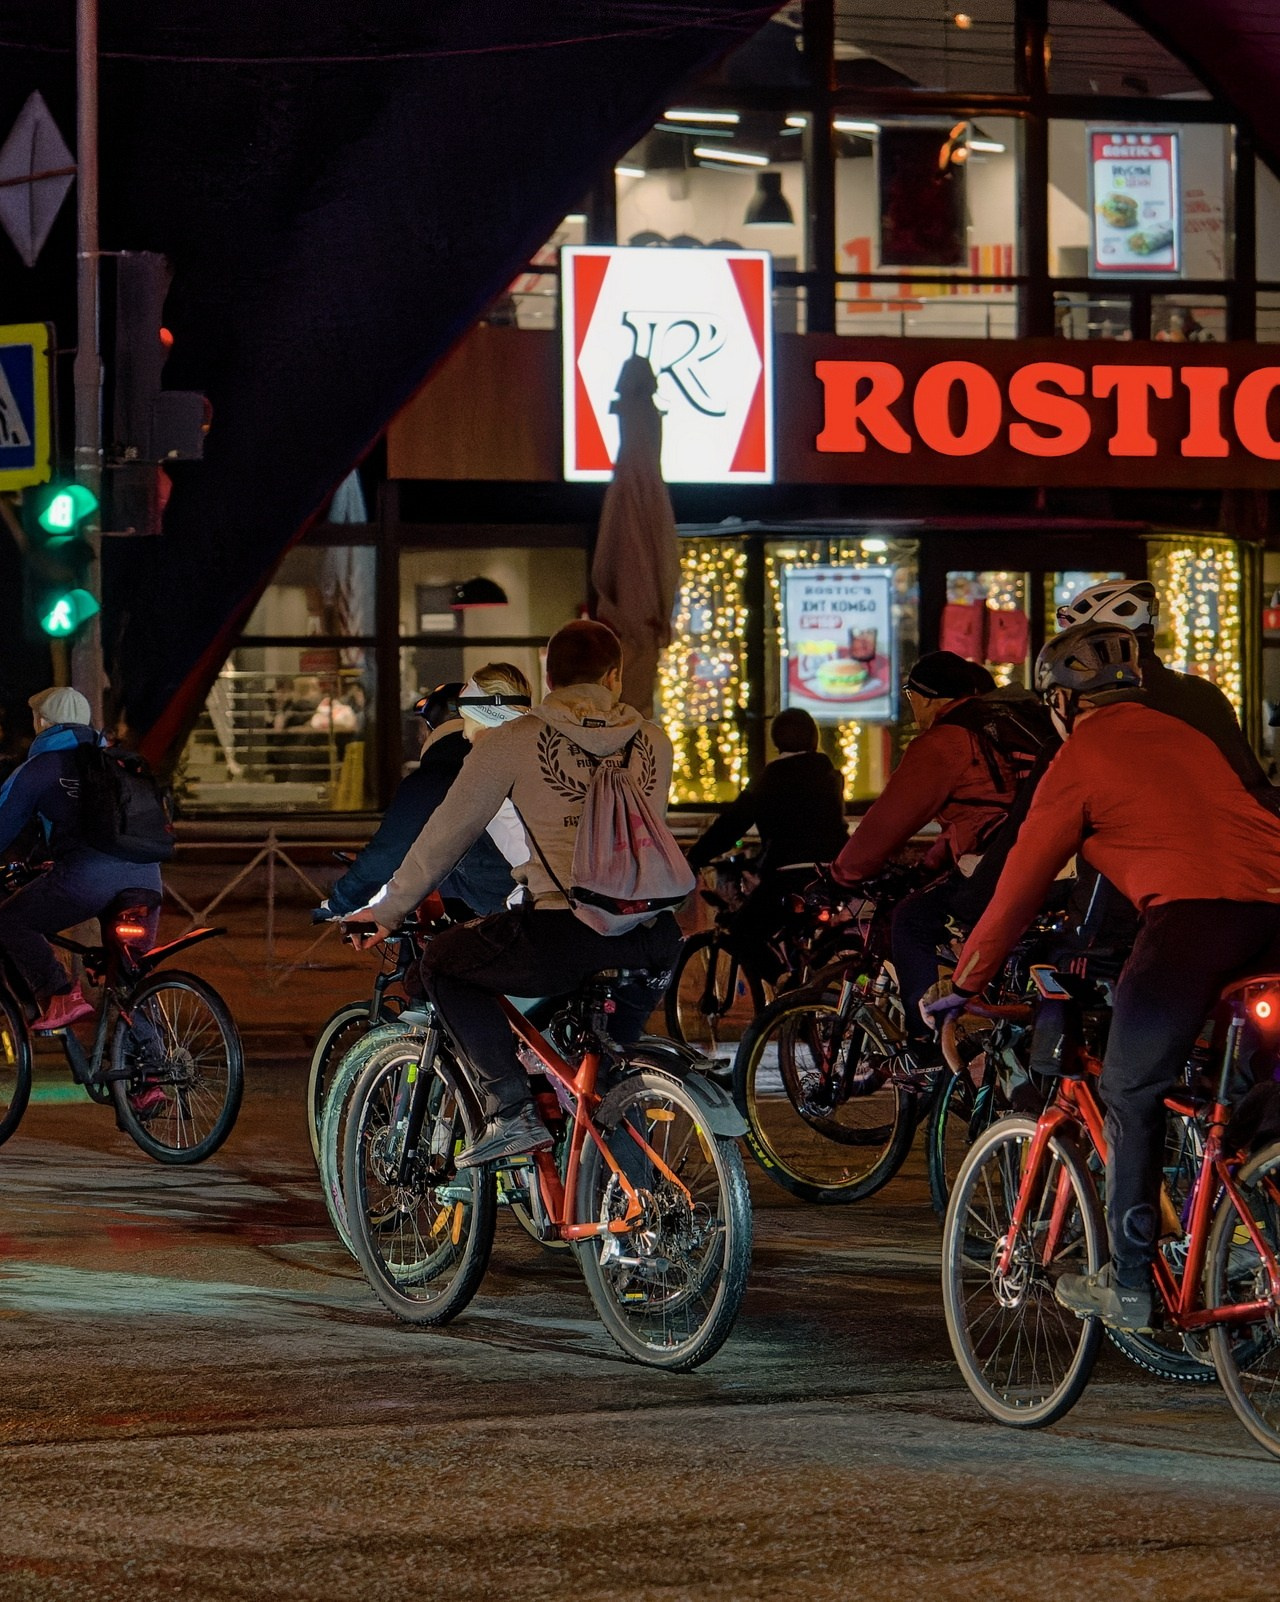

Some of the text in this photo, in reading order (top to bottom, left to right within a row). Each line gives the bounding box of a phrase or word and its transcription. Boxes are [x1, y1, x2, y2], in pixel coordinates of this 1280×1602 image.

[804, 586, 872, 595] ROSTIC'S
[801, 601, 876, 612] ХИТ КОМБО
